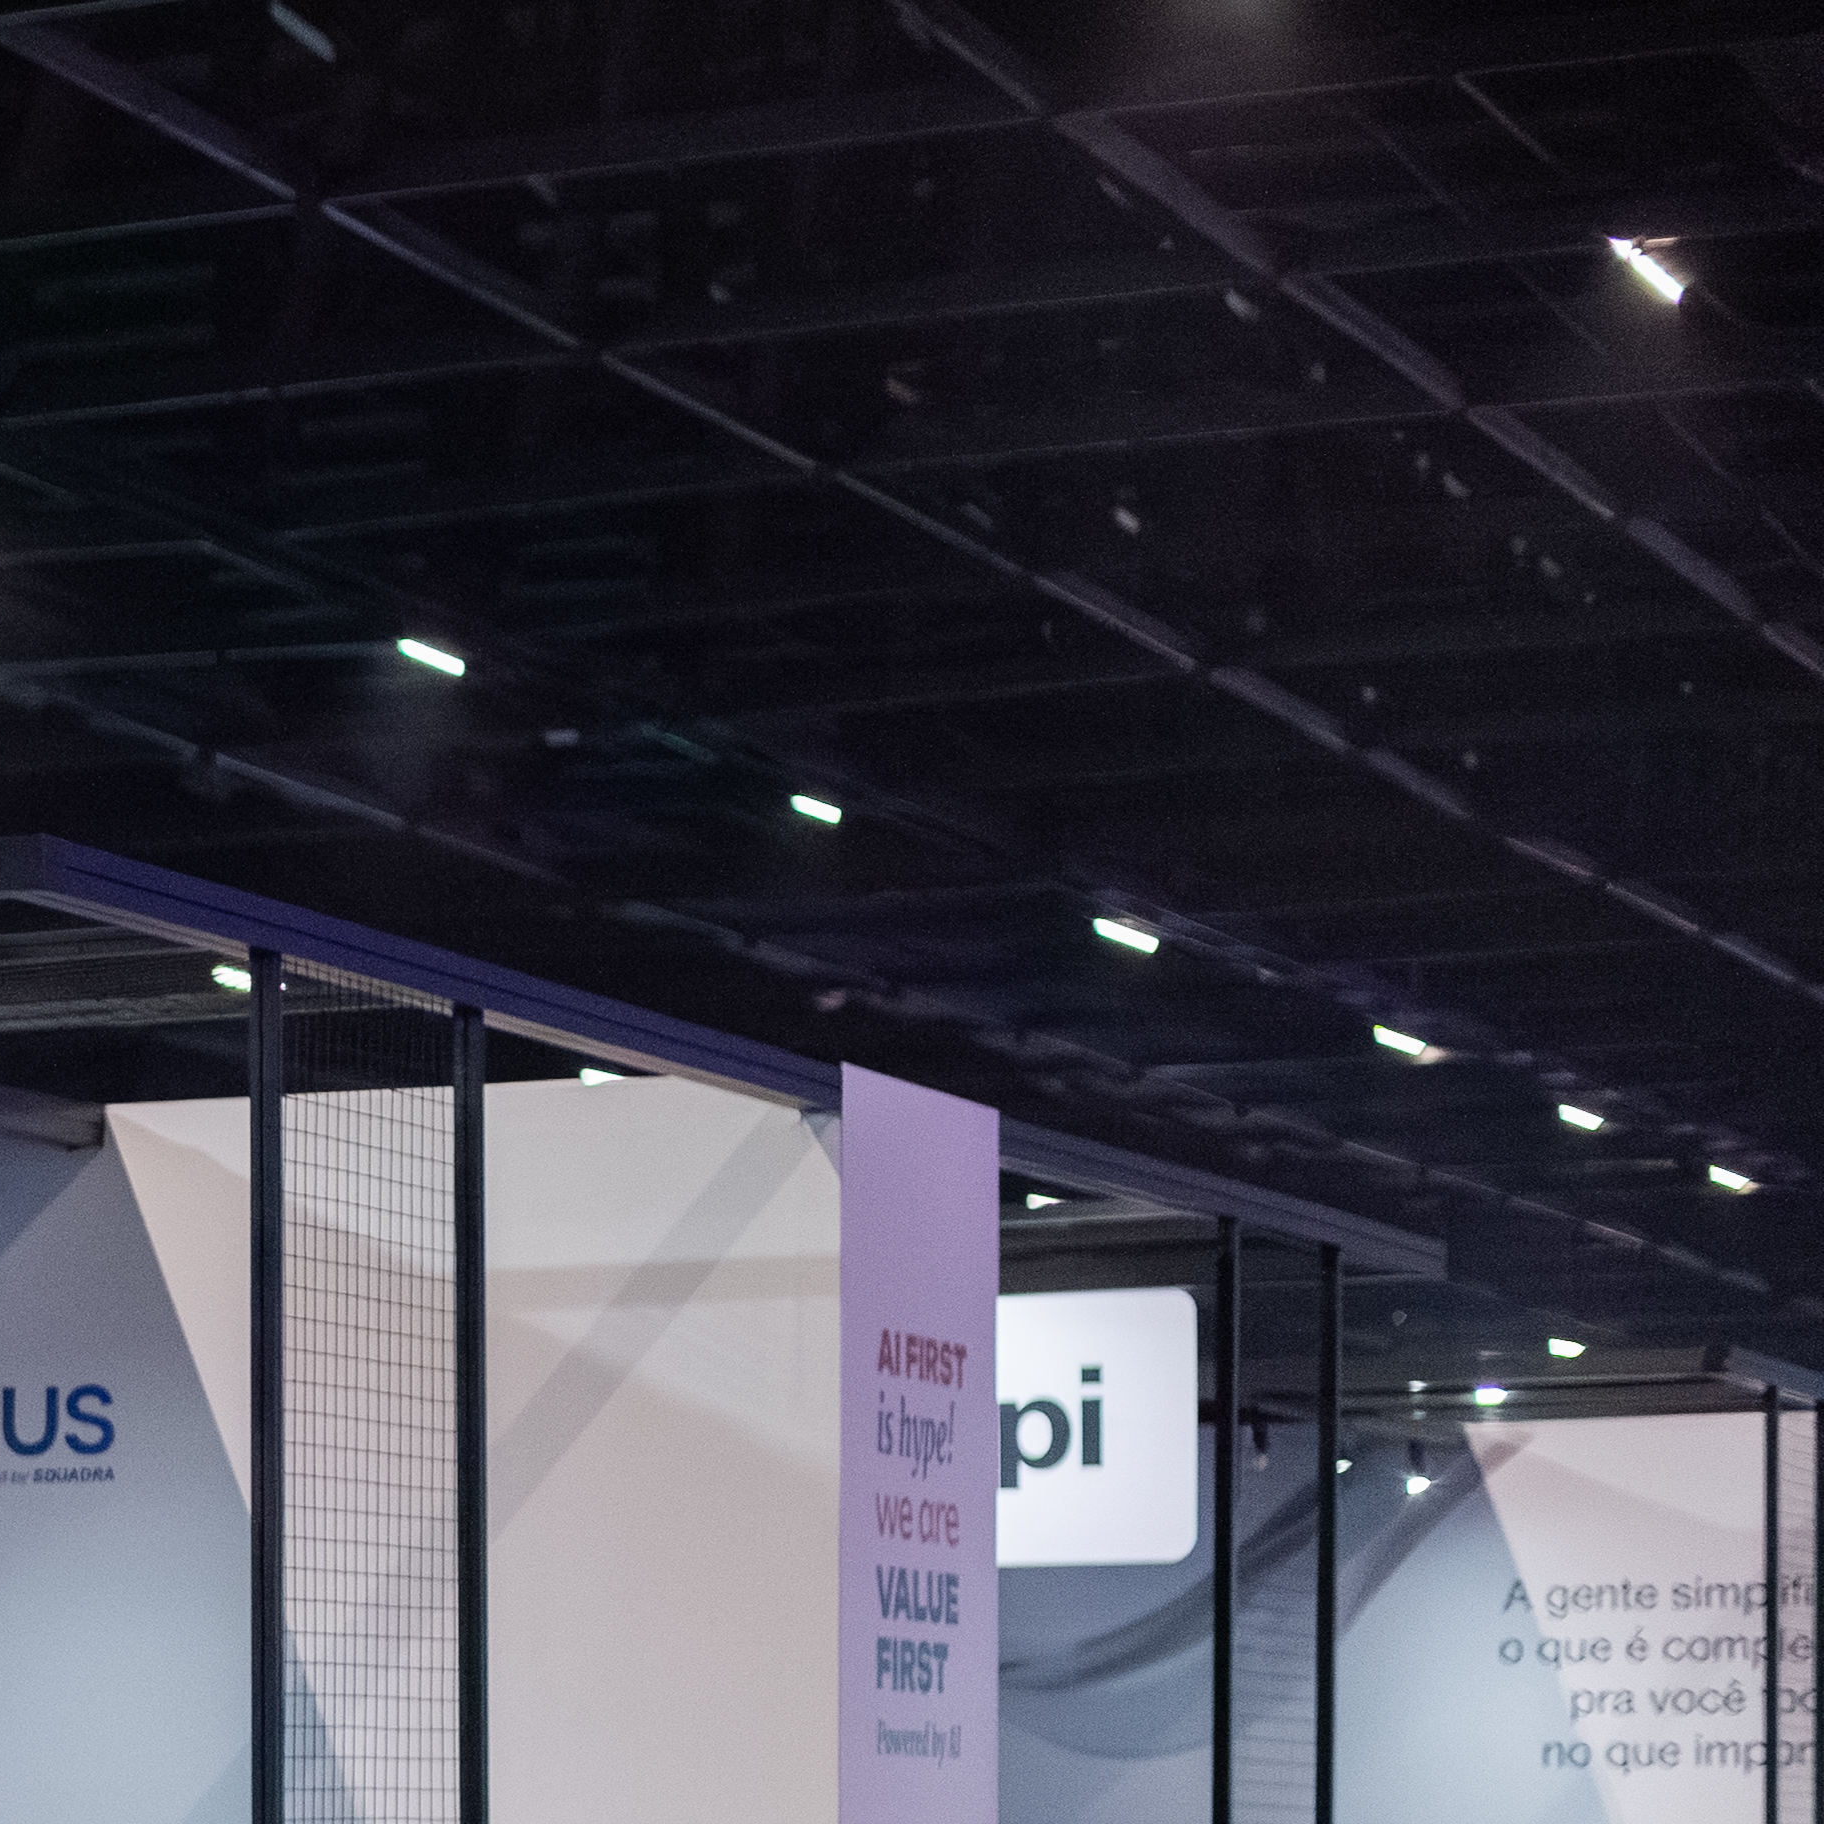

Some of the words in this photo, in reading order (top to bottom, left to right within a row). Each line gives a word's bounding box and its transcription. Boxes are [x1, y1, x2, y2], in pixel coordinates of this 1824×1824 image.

[878, 1328, 901, 1376] AI
[905, 1334, 967, 1389] FIRST
[877, 1390, 893, 1455] is
[900, 1394, 955, 1481] hype!
[1000, 1365, 1102, 1488] pi
[919, 1498, 960, 1547] are
[876, 1564, 959, 1625] VALUE
[1502, 1577, 1533, 1613] A
[1545, 1577, 1658, 1620] gente
[876, 1636, 950, 1695] FIRST
[1498, 1635, 1525, 1665] o
[1536, 1635, 1613, 1671] que
[1625, 1625, 1649, 1663] é
[1570, 1687, 1636, 1727] pra
[1649, 1678, 1747, 1715] você
[1541, 1740, 1593, 1768] no
[1605, 1740, 1682, 1775] que
